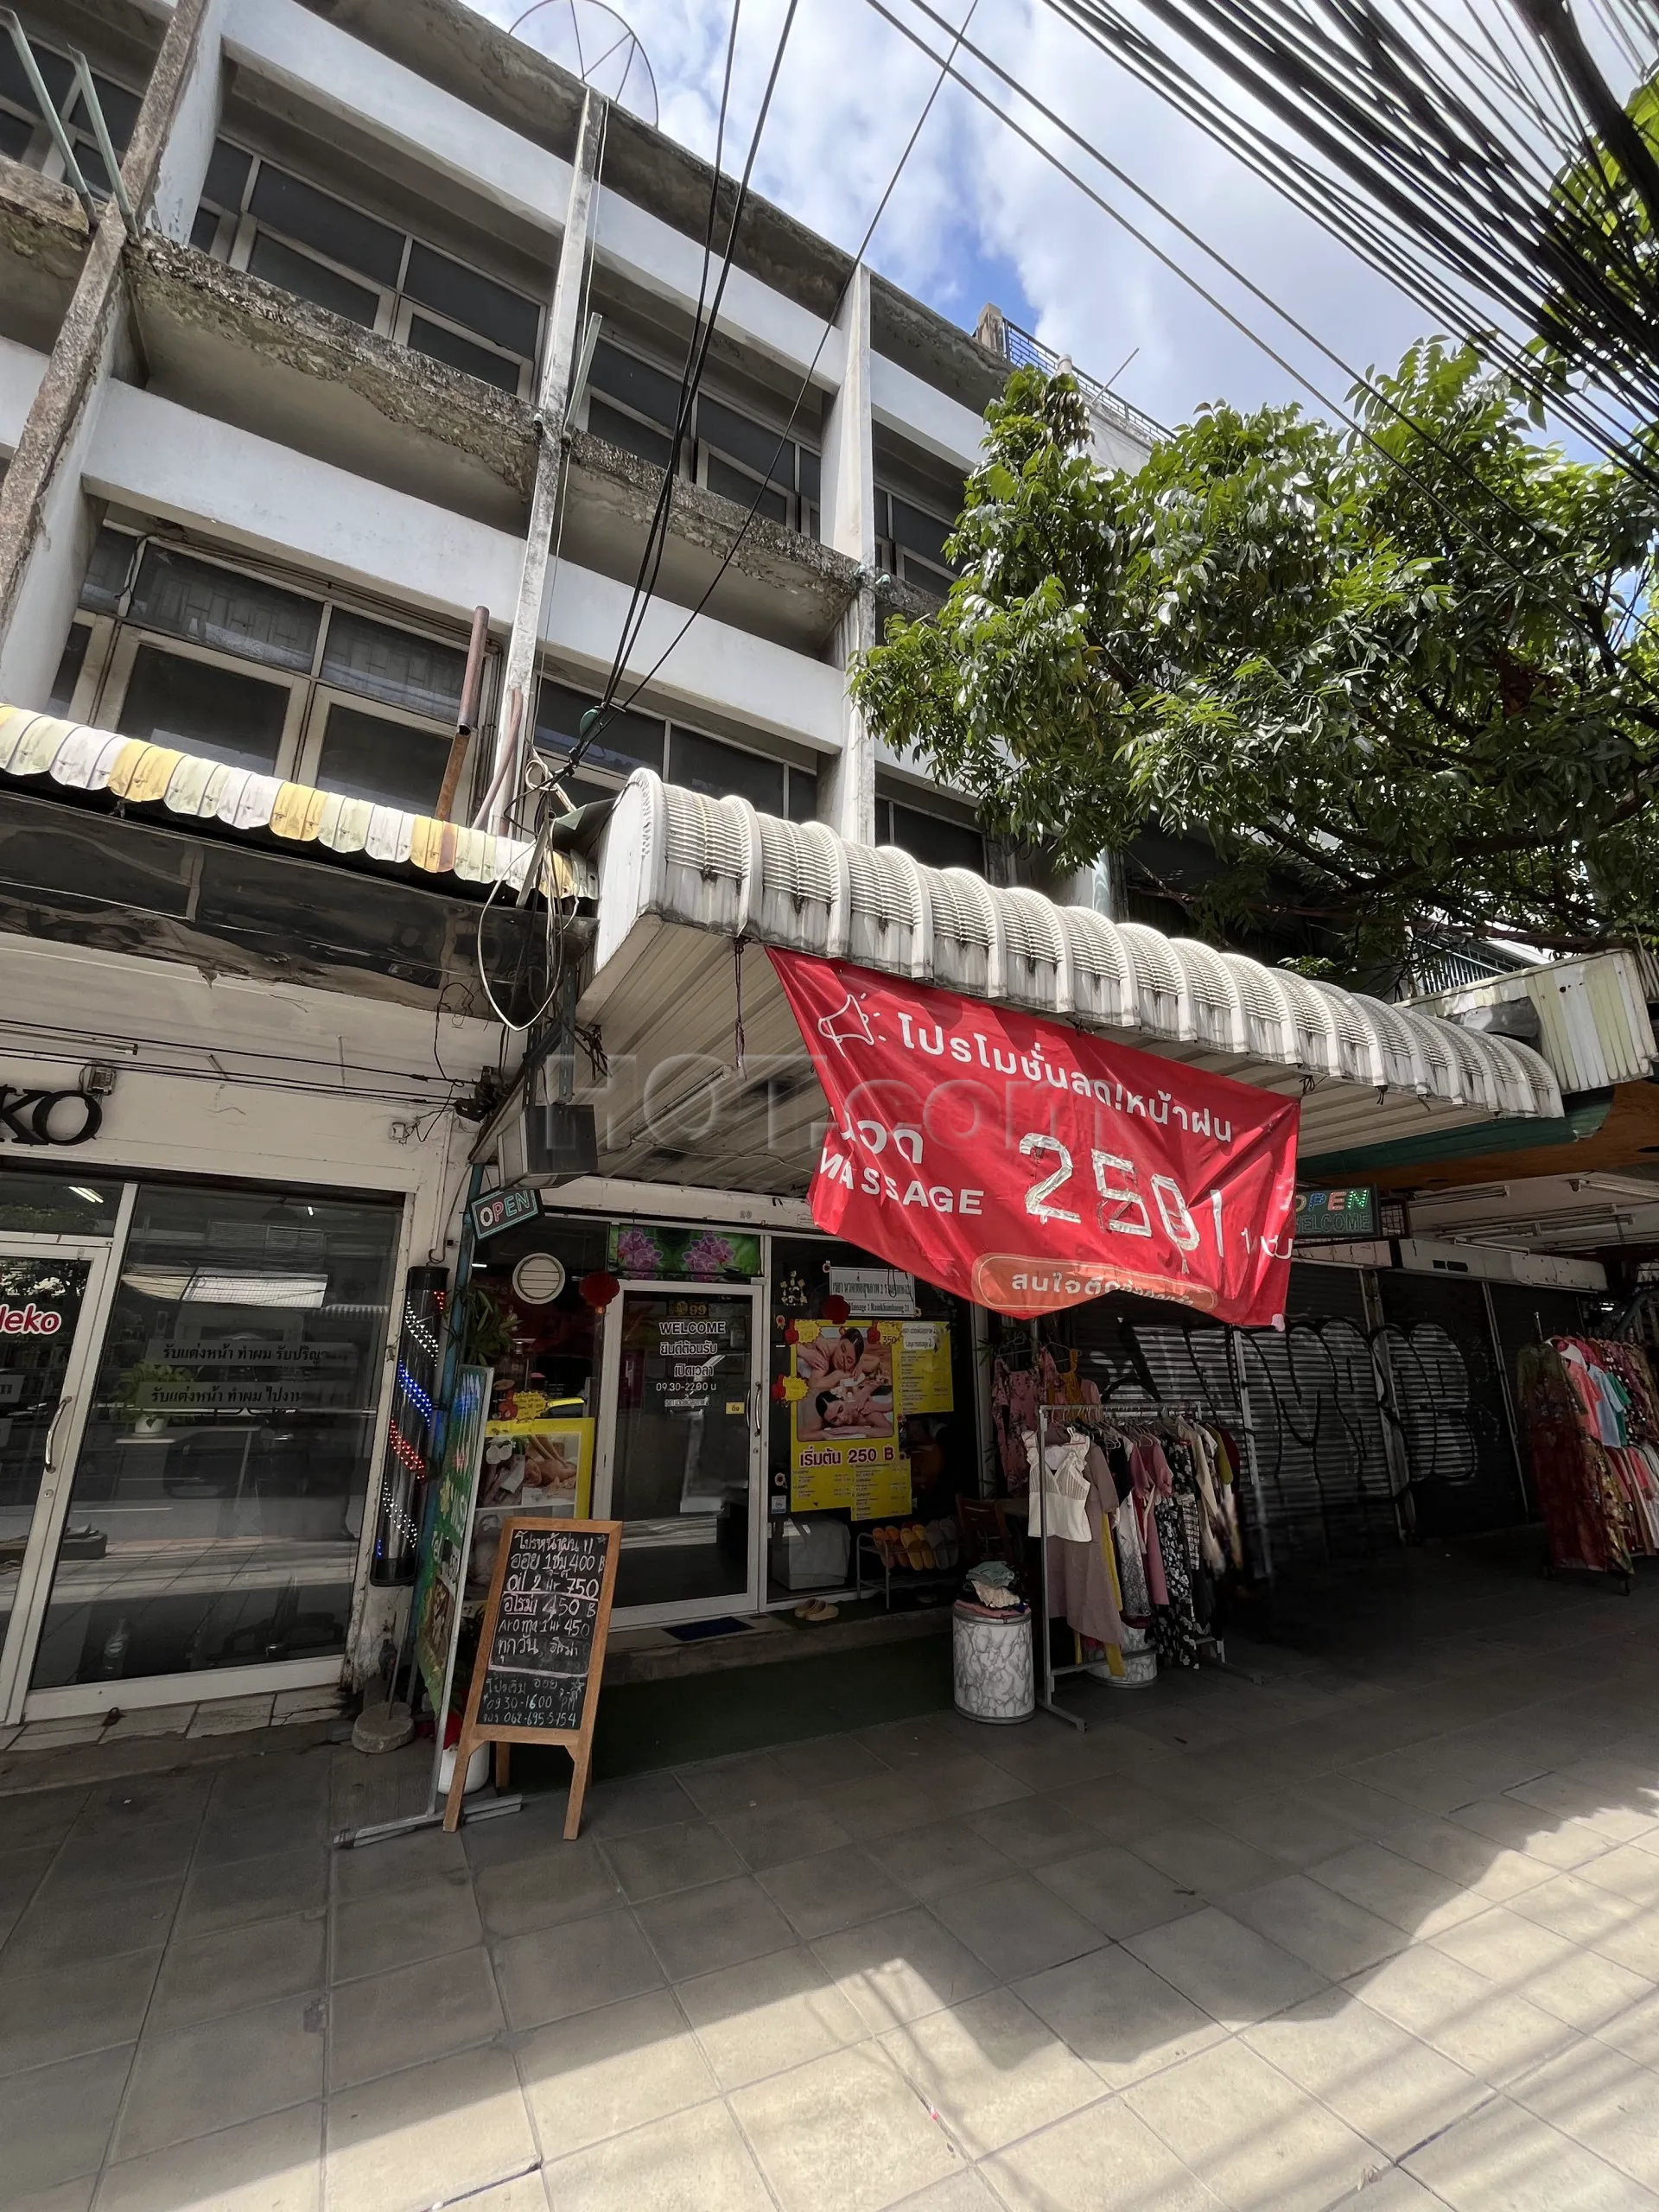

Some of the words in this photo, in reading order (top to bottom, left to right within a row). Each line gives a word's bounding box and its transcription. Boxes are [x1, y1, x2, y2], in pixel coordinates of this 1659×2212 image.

[820, 1147, 984, 1215] MASSAGE
[480, 1190, 530, 1227] OPEN
[1296, 1212, 1372, 1233] ELCOME
[0, 1303, 62, 1335] eko
[659, 1321, 726, 1335] WELCOME
[163, 1343, 233, 1359] รับแต่งหน้า
[238, 1345, 271, 1360] ทำผม
[659, 1340, 717, 1356] ยินดีต้อนรับ
[674, 1363, 715, 1377] เปิดเวลา
[151, 1387, 223, 1402] รับแต่งหน้า
[227, 1389, 261, 1402] ทำผม
[799, 1445, 842, 1467] เริ่มต้น
[848, 1447, 877, 1464] 250
[569, 1554, 594, 1573] 400
[531, 1573, 542, 1591] 2
[566, 1577, 600, 1598] 750
[564, 1618, 590, 1637] 450
